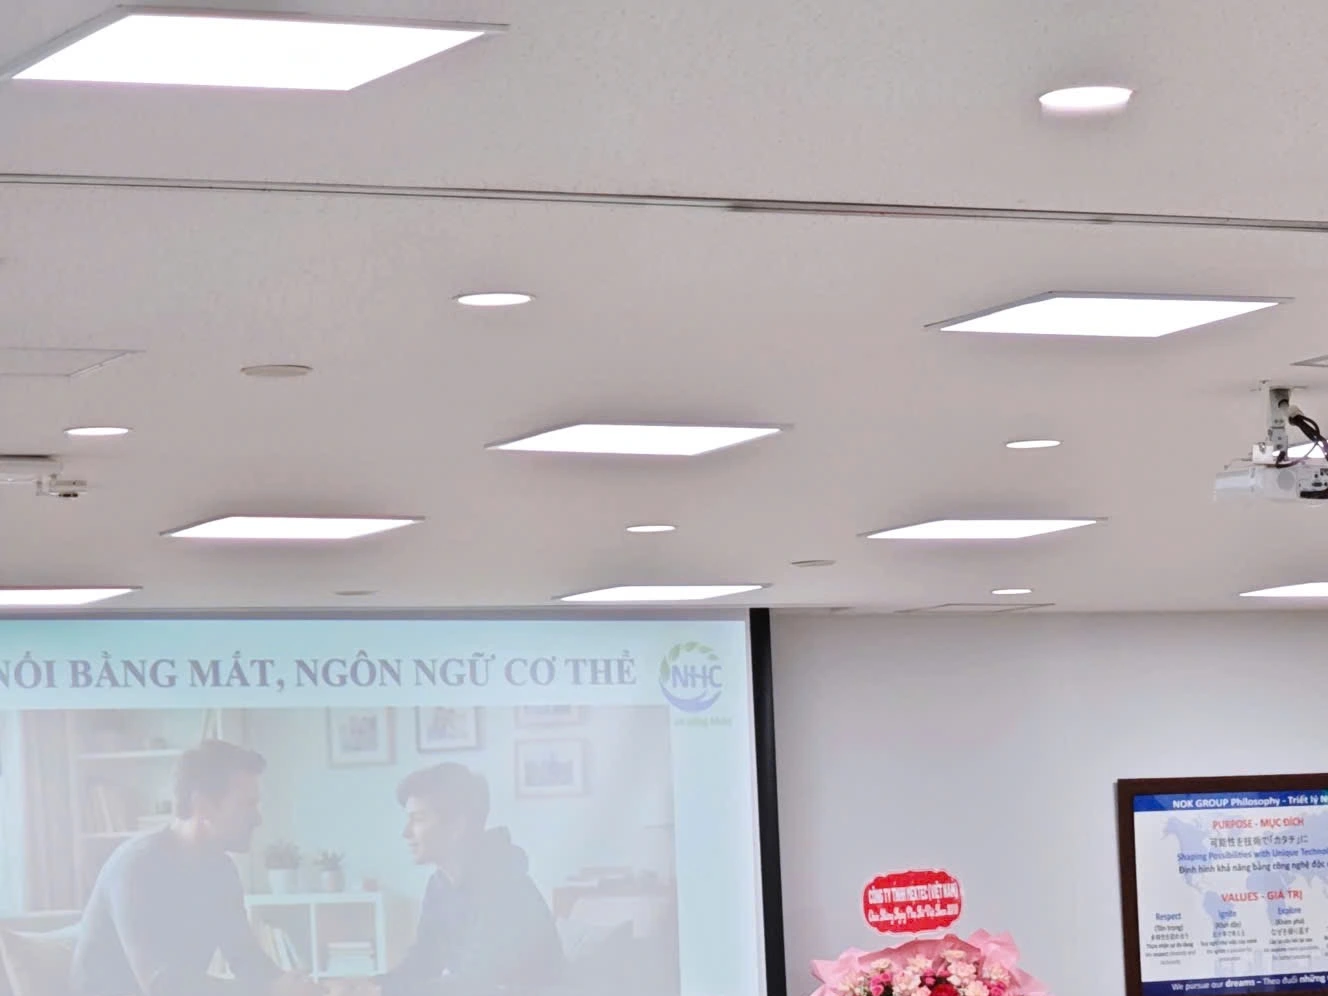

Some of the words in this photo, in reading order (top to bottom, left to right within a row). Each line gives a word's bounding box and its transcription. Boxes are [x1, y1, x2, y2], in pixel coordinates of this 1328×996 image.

[68, 650, 177, 688] BẰNG
[188, 650, 286, 692] MẮT,
[295, 649, 402, 687] NGÔN
[413, 651, 496, 687] NGỮ
[504, 655, 557, 686] CƠ
[564, 649, 637, 686] THỂ
[671, 664, 723, 689] NHC
[1173, 799, 1193, 808] NOK
[1195, 798, 1228, 808] GROUP
[1231, 797, 1280, 807] Philosophy
[1212, 819, 1253, 830] PURPOSE
[1260, 818, 1281, 829] MỤC
[1283, 816, 1304, 827] ĐÍCH
[1177, 853, 1207, 862] Shaping
[1209, 851, 1252, 861] Possibilities
[1254, 850, 1270, 858] with
[1272, 849, 1298, 859] Unique
[1221, 892, 1259, 902] VALUES
[1267, 889, 1284, 900] GIÁ
[1287, 889, 1303, 900] TRỊ
[1171, 983, 1183, 991] We
[1185, 982, 1210, 992] pursue
[1225, 979, 1256, 988] dreams
[1263, 977, 1281, 986] Theo
[1299, 973, 1325, 984] những
